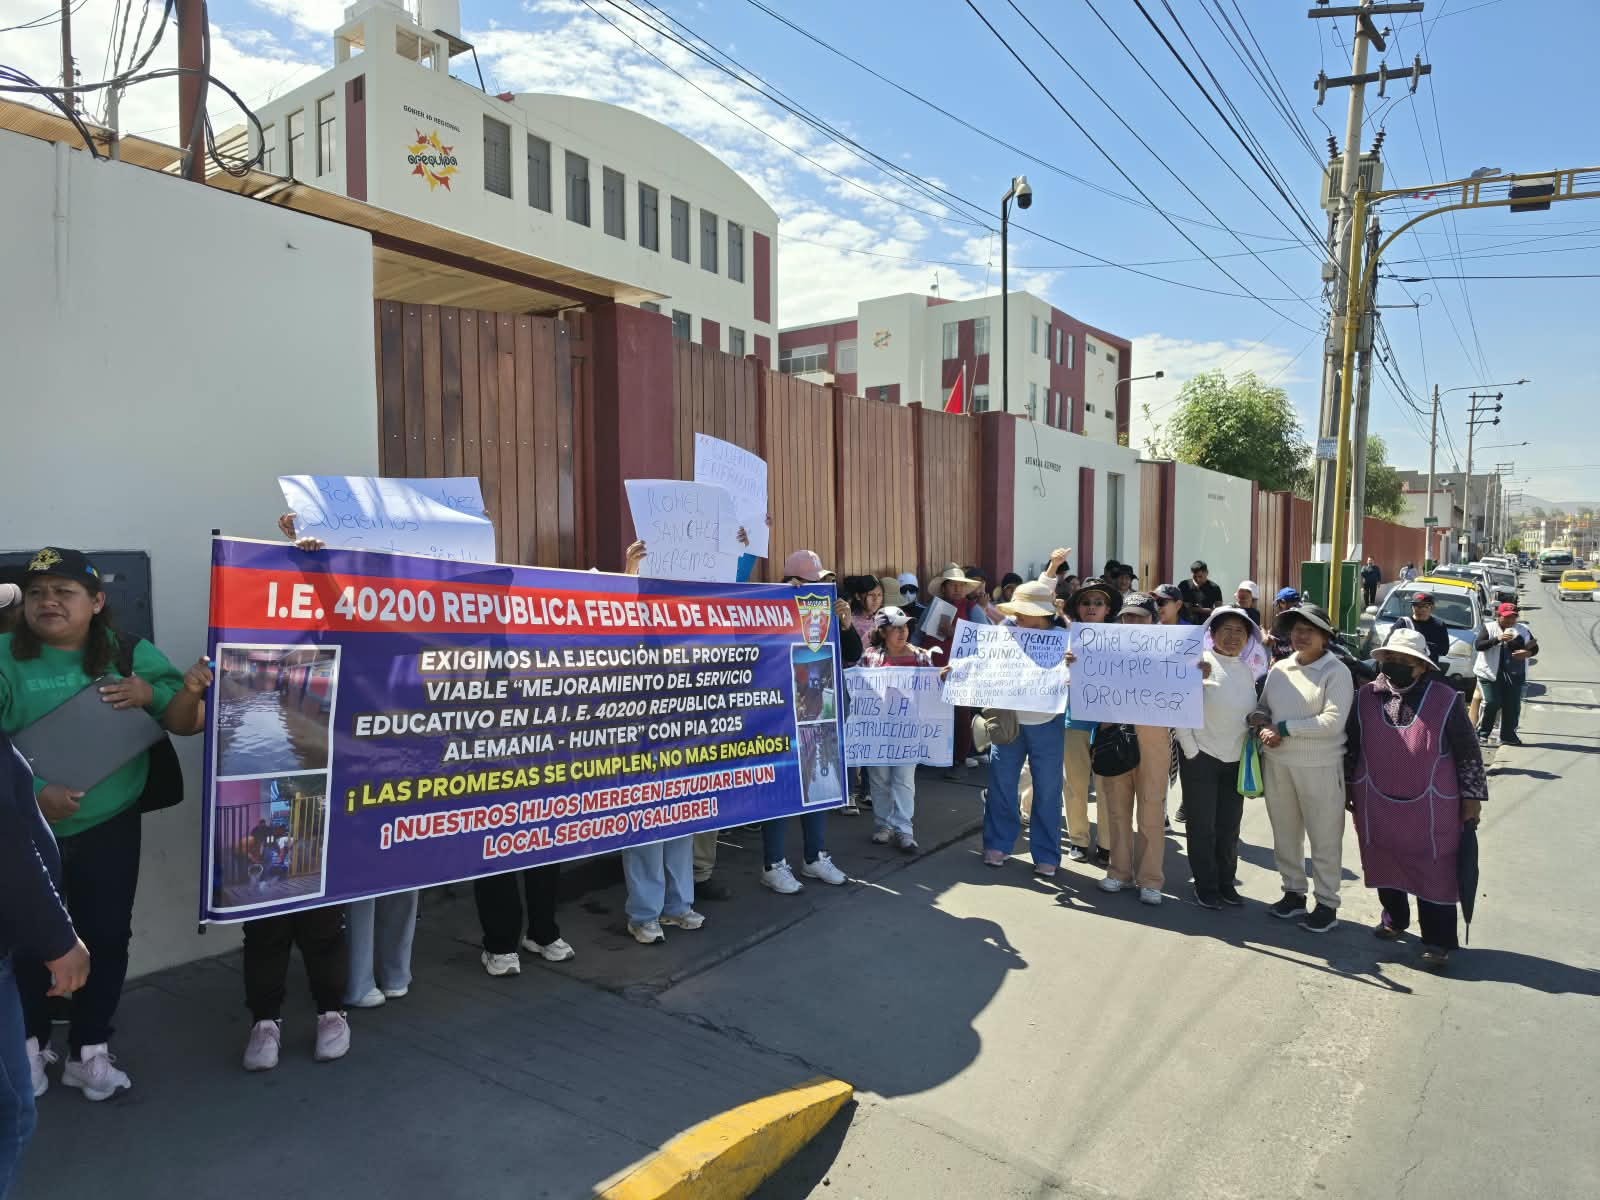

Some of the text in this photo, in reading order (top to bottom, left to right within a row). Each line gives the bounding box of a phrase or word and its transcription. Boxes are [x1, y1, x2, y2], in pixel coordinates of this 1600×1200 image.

[267, 582, 794, 628] I.E. 40200 REPUBLICA FEDERAL DE ALEMANIA
[956, 647, 963, 658] A
[961, 626, 998, 643] BASTA
[421, 645, 759, 671] EXIGIMOS LA EJECUCIÓN DEL PROYECTO
[427, 680, 508, 701] VIABLE
[667, 672, 692, 690] DEL
[695, 669, 752, 687] SERVICIO
[355, 710, 495, 736] EDUCATIVO
[500, 708, 529, 727] EN
[533, 706, 557, 725] LA
[594, 699, 647, 720] 40200
[649, 694, 726, 716] REPUBLICA
[728, 689, 784, 707] FEDERAL
[887, 696, 909, 717] LA
[443, 733, 554, 762] ALEMANIA
[648, 722, 681, 739] CON
[684, 720, 708, 736] PIA
[710, 716, 743, 733] 2025
[921, 723, 944, 739] DE
[417, 767, 541, 799] PROMESAS
[544, 764, 566, 783] SE
[570, 754, 657, 780] CUMPLEN,
[659, 750, 682, 768] NO
[685, 745, 718, 764] MAS
[520, 793, 580, 823] HIJOS
[581, 781, 662, 814] MERECEN
[663, 771, 733, 799] ESTUDIAR
[734, 768, 753, 786] EN
[754, 765, 775, 783] UN
[483, 827, 553, 859] LOCAL
[555, 814, 629, 846] SEGURO
[629, 810, 643, 832] Y
